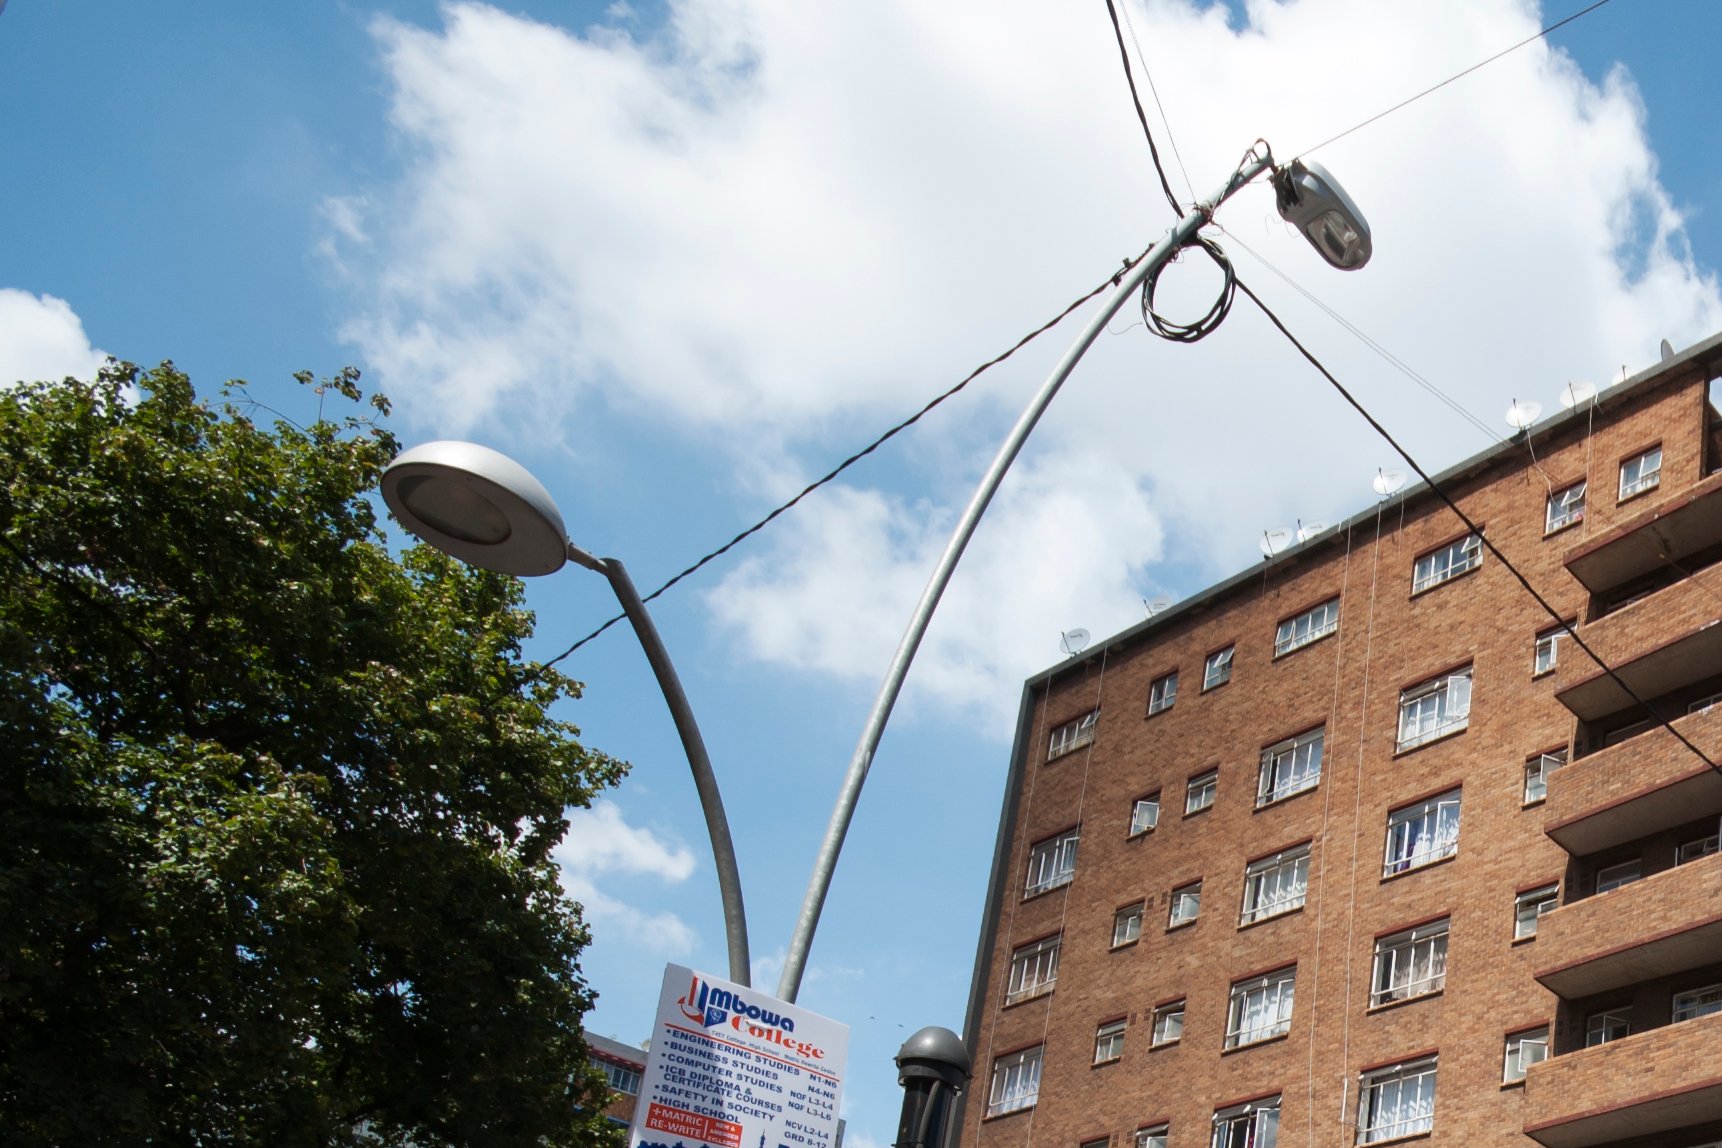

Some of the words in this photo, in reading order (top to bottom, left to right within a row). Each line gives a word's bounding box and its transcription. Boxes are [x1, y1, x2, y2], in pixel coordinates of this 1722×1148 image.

[671, 1029, 751, 1060] ENGINEERING
[754, 1055, 800, 1076] STUDIES
[809, 1073, 837, 1088] N1-N6
[729, 1013, 826, 1063] College
[663, 1071, 732, 1098] CERTIFICATE
[735, 1092, 782, 1113] COURSES
[665, 1064, 686, 1076] ICB
[689, 1070, 741, 1092] DIPLOMA
[745, 1087, 752, 1095] &
[788, 1101, 804, 1111] NQF
[806, 1107, 831, 1121] L3-L6
[667, 1052, 732, 1078] COMPUTER
[736, 1072, 783, 1093] STUDIES
[789, 1090, 806, 1101] NQF
[808, 1096, 833, 1110] L3-L4
[669, 1041, 728, 1065] BUSINESS
[731, 1059, 778, 1080] STUDIES
[807, 1085, 835, 1099] N4-N6
[650, 1117, 701, 1138] RE-WRITE
[658, 1095, 689, 1110] HIGH
[693, 1104, 740, 1124] SCHOOL
[783, 1130, 804, 1143] GRD
[660, 1083, 708, 1103] SAFETY
[711, 1097, 723, 1107] IN
[726, 1101, 774, 1122] SOCIETY
[785, 1119, 802, 1130] NCV
[803, 1125, 828, 1140] L2-L4
